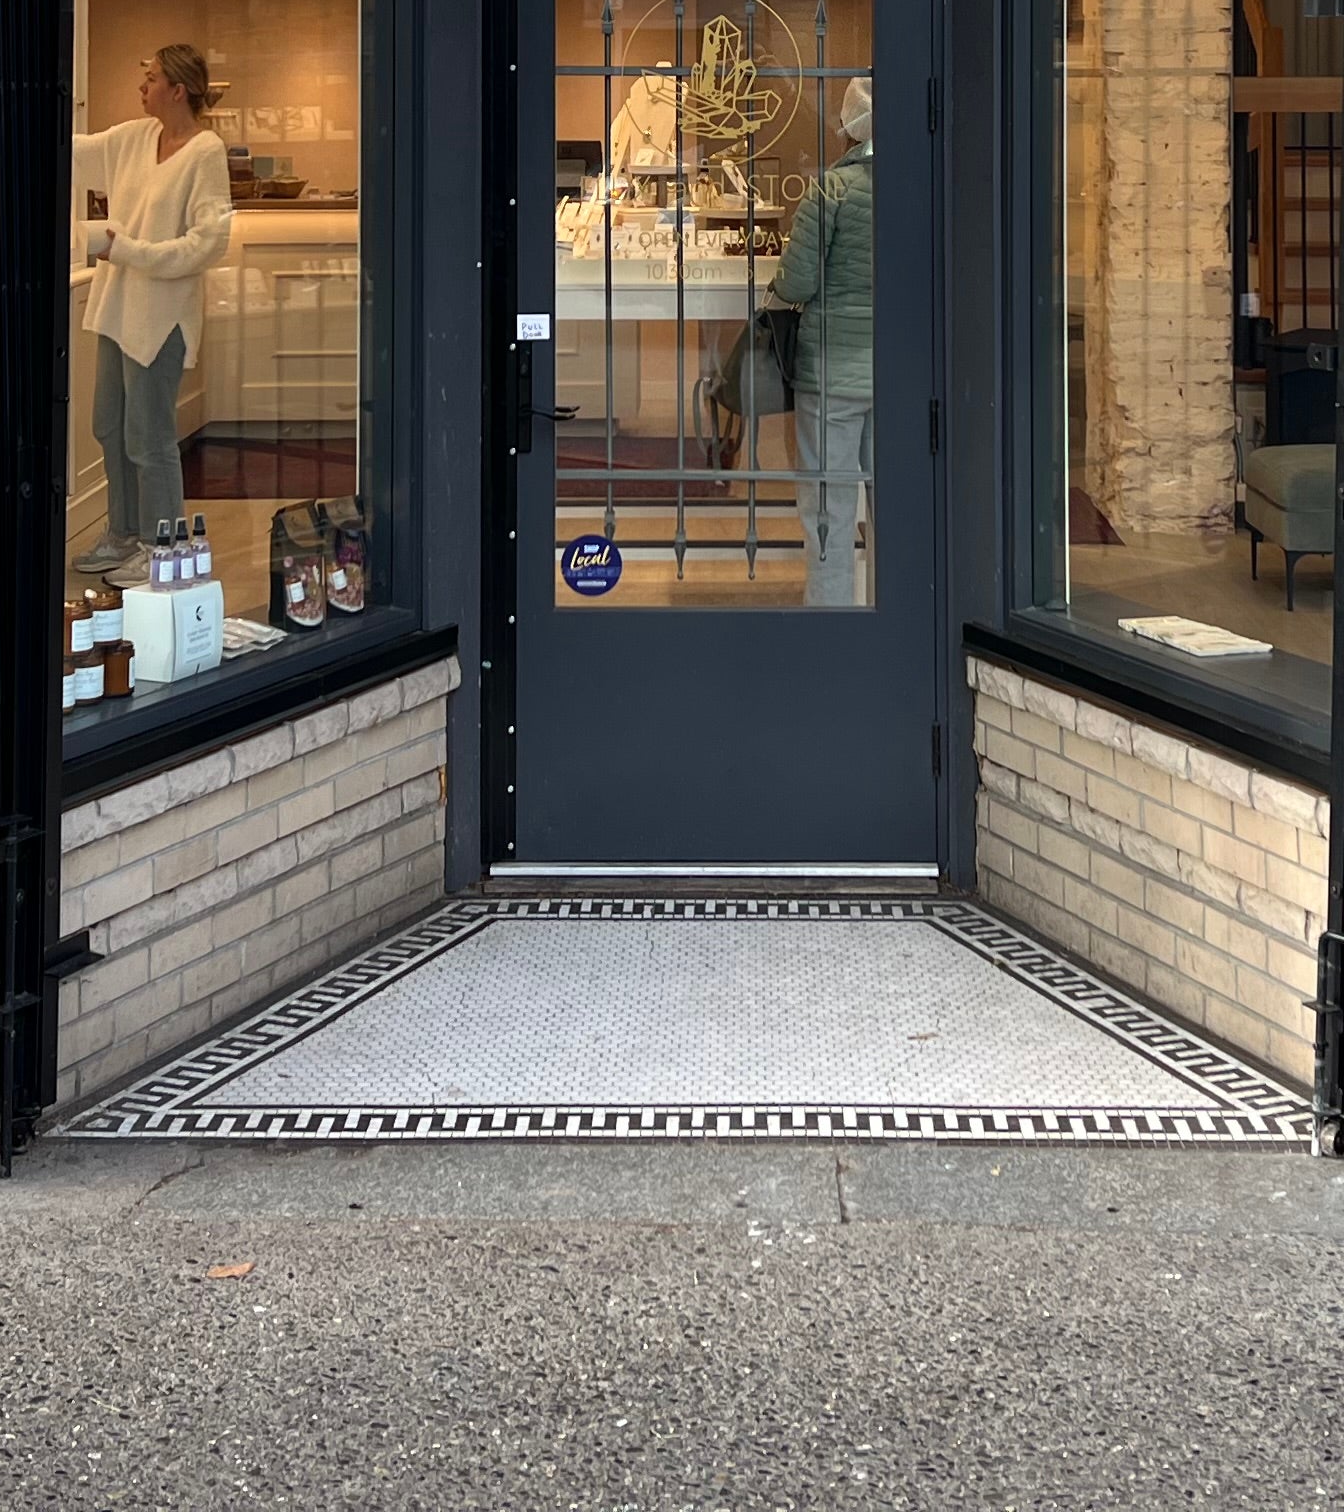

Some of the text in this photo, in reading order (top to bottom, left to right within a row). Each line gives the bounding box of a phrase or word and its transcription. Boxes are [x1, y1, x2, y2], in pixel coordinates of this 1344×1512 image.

[747, 174, 848, 202] STONE
[638, 231, 791, 250] OPEN EVERYDAY
[570, 544, 612, 571] Local
